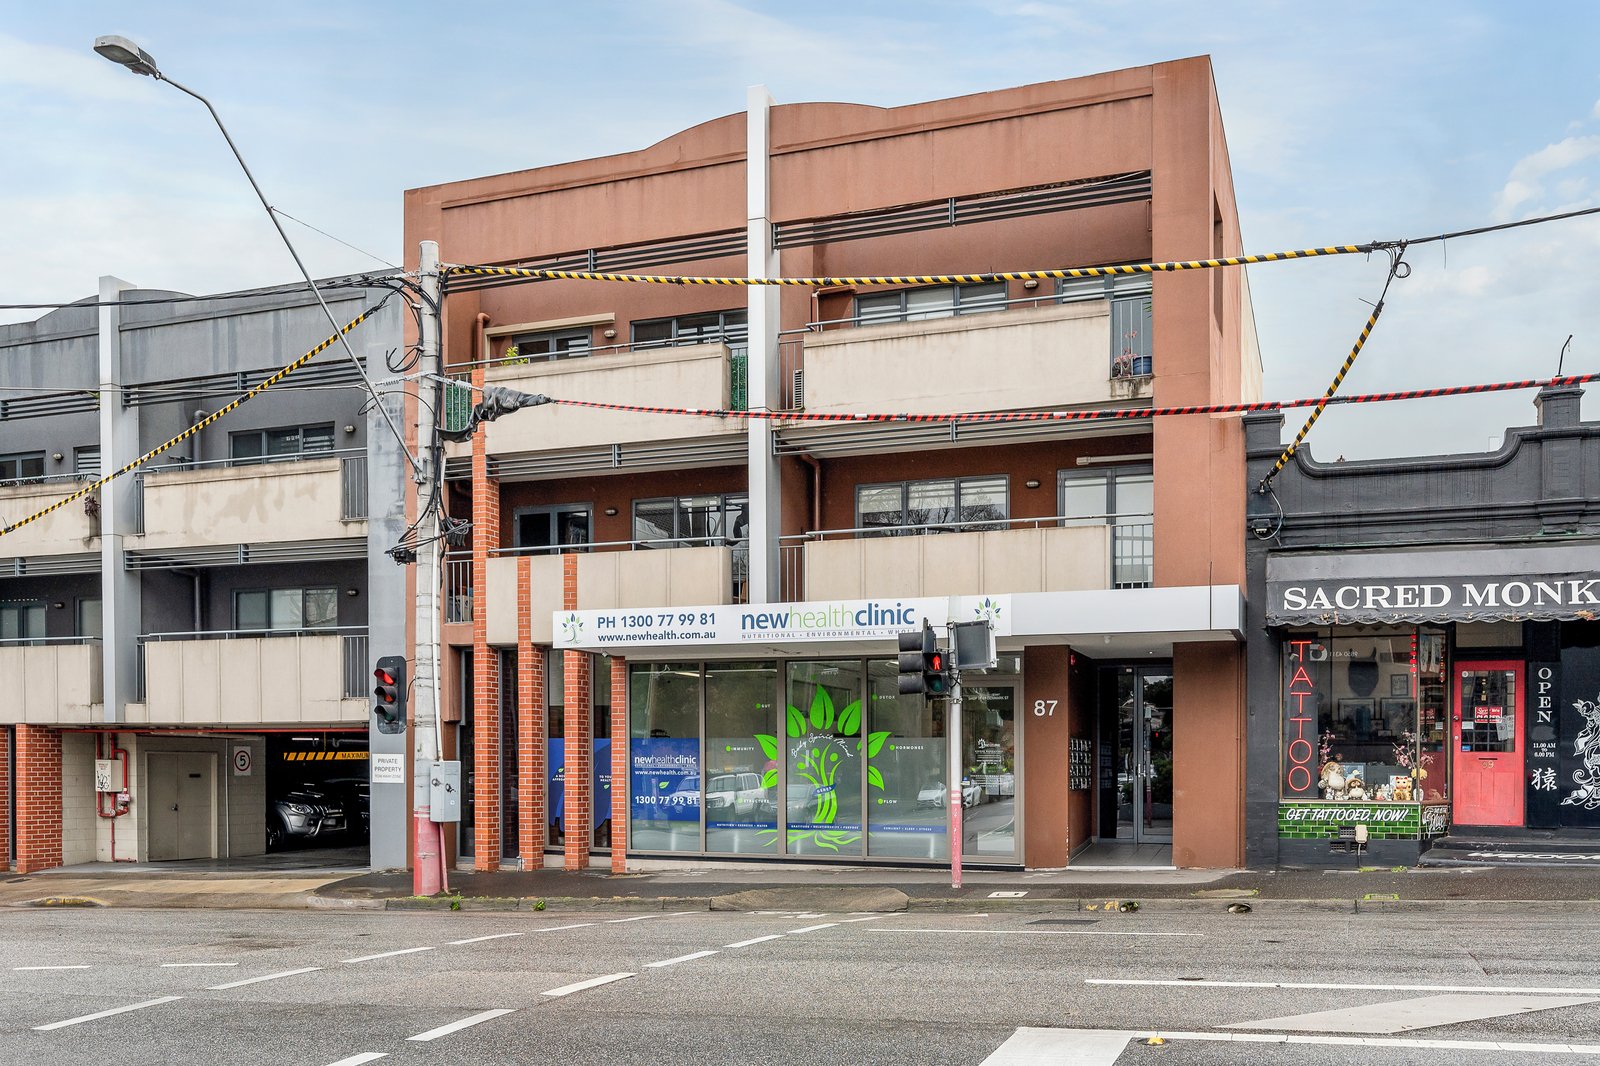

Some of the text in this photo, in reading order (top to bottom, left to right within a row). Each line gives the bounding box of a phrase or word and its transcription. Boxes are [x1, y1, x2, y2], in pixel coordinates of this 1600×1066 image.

[1283, 579, 1600, 611] SACRED MONK
[597, 612, 716, 629] PH 1300 77 99 81
[741, 602, 915, 630] newhealthclinic
[598, 630, 716, 642] www.newhealth.com.au
[806, 630, 876, 638] ENVIRONMENTAL
[1536, 667, 1553, 723] OPEN
[1033, 700, 1058, 717] 87
[1288, 640, 1313, 792] TATTOO
[791, 740, 807, 758] Body
[808, 732, 834, 743] Spirit
[239, 755, 246, 767] 5
[634, 754, 696, 764] newhealthclinic
[1531, 767, 1558, 792] 猿
[635, 795, 698, 806] 1300 77 99 81
[1286, 808, 1308, 821] GET
[1373, 808, 1409, 821] NOW!
